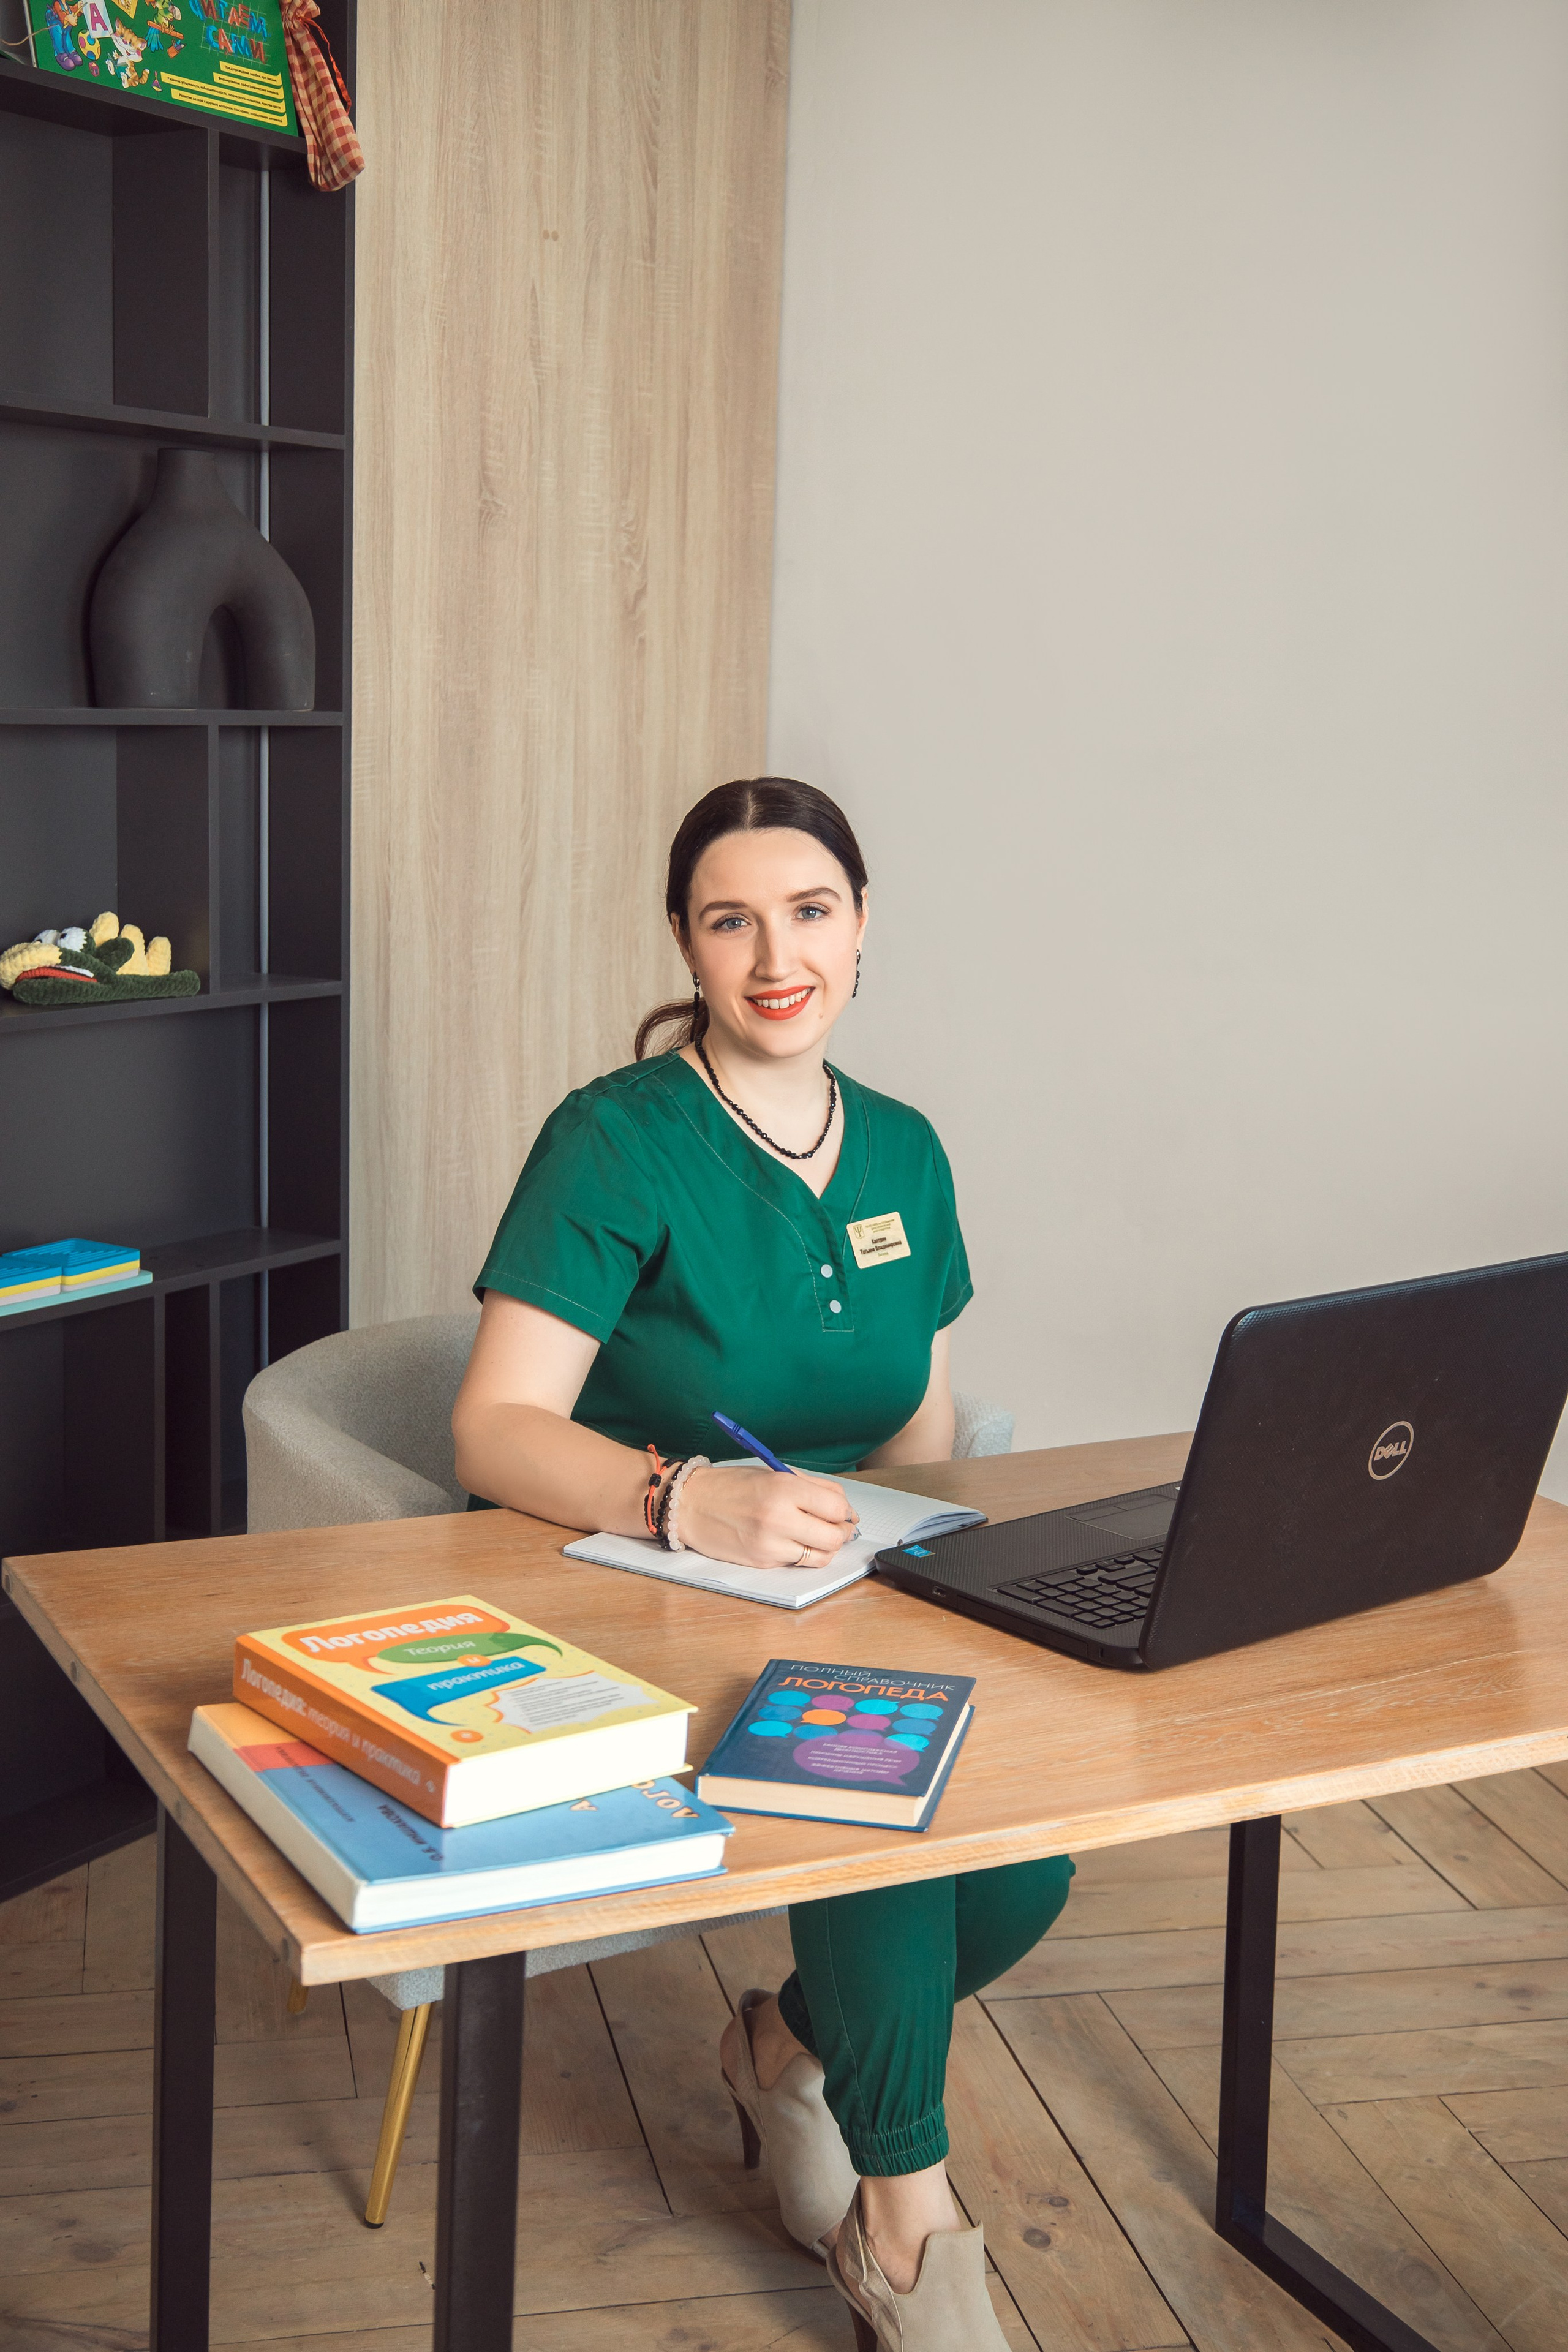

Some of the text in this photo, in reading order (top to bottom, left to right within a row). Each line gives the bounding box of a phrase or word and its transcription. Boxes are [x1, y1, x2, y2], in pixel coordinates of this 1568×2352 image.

[206, 25, 266, 64] САМИ
[1373, 1441, 1407, 1461] DELL
[299, 1612, 483, 1653] Логопедия
[403, 1640, 477, 1656] Теория
[426, 1661, 525, 1692] практика
[791, 1664, 872, 1677] ПОЛНЫЙ
[834, 1675, 956, 1691] СПРАВОЧНИК
[778, 1676, 949, 1702] ЛОГОПЕДА
[308, 1706, 350, 1742] теория
[361, 1740, 421, 1786] практика
